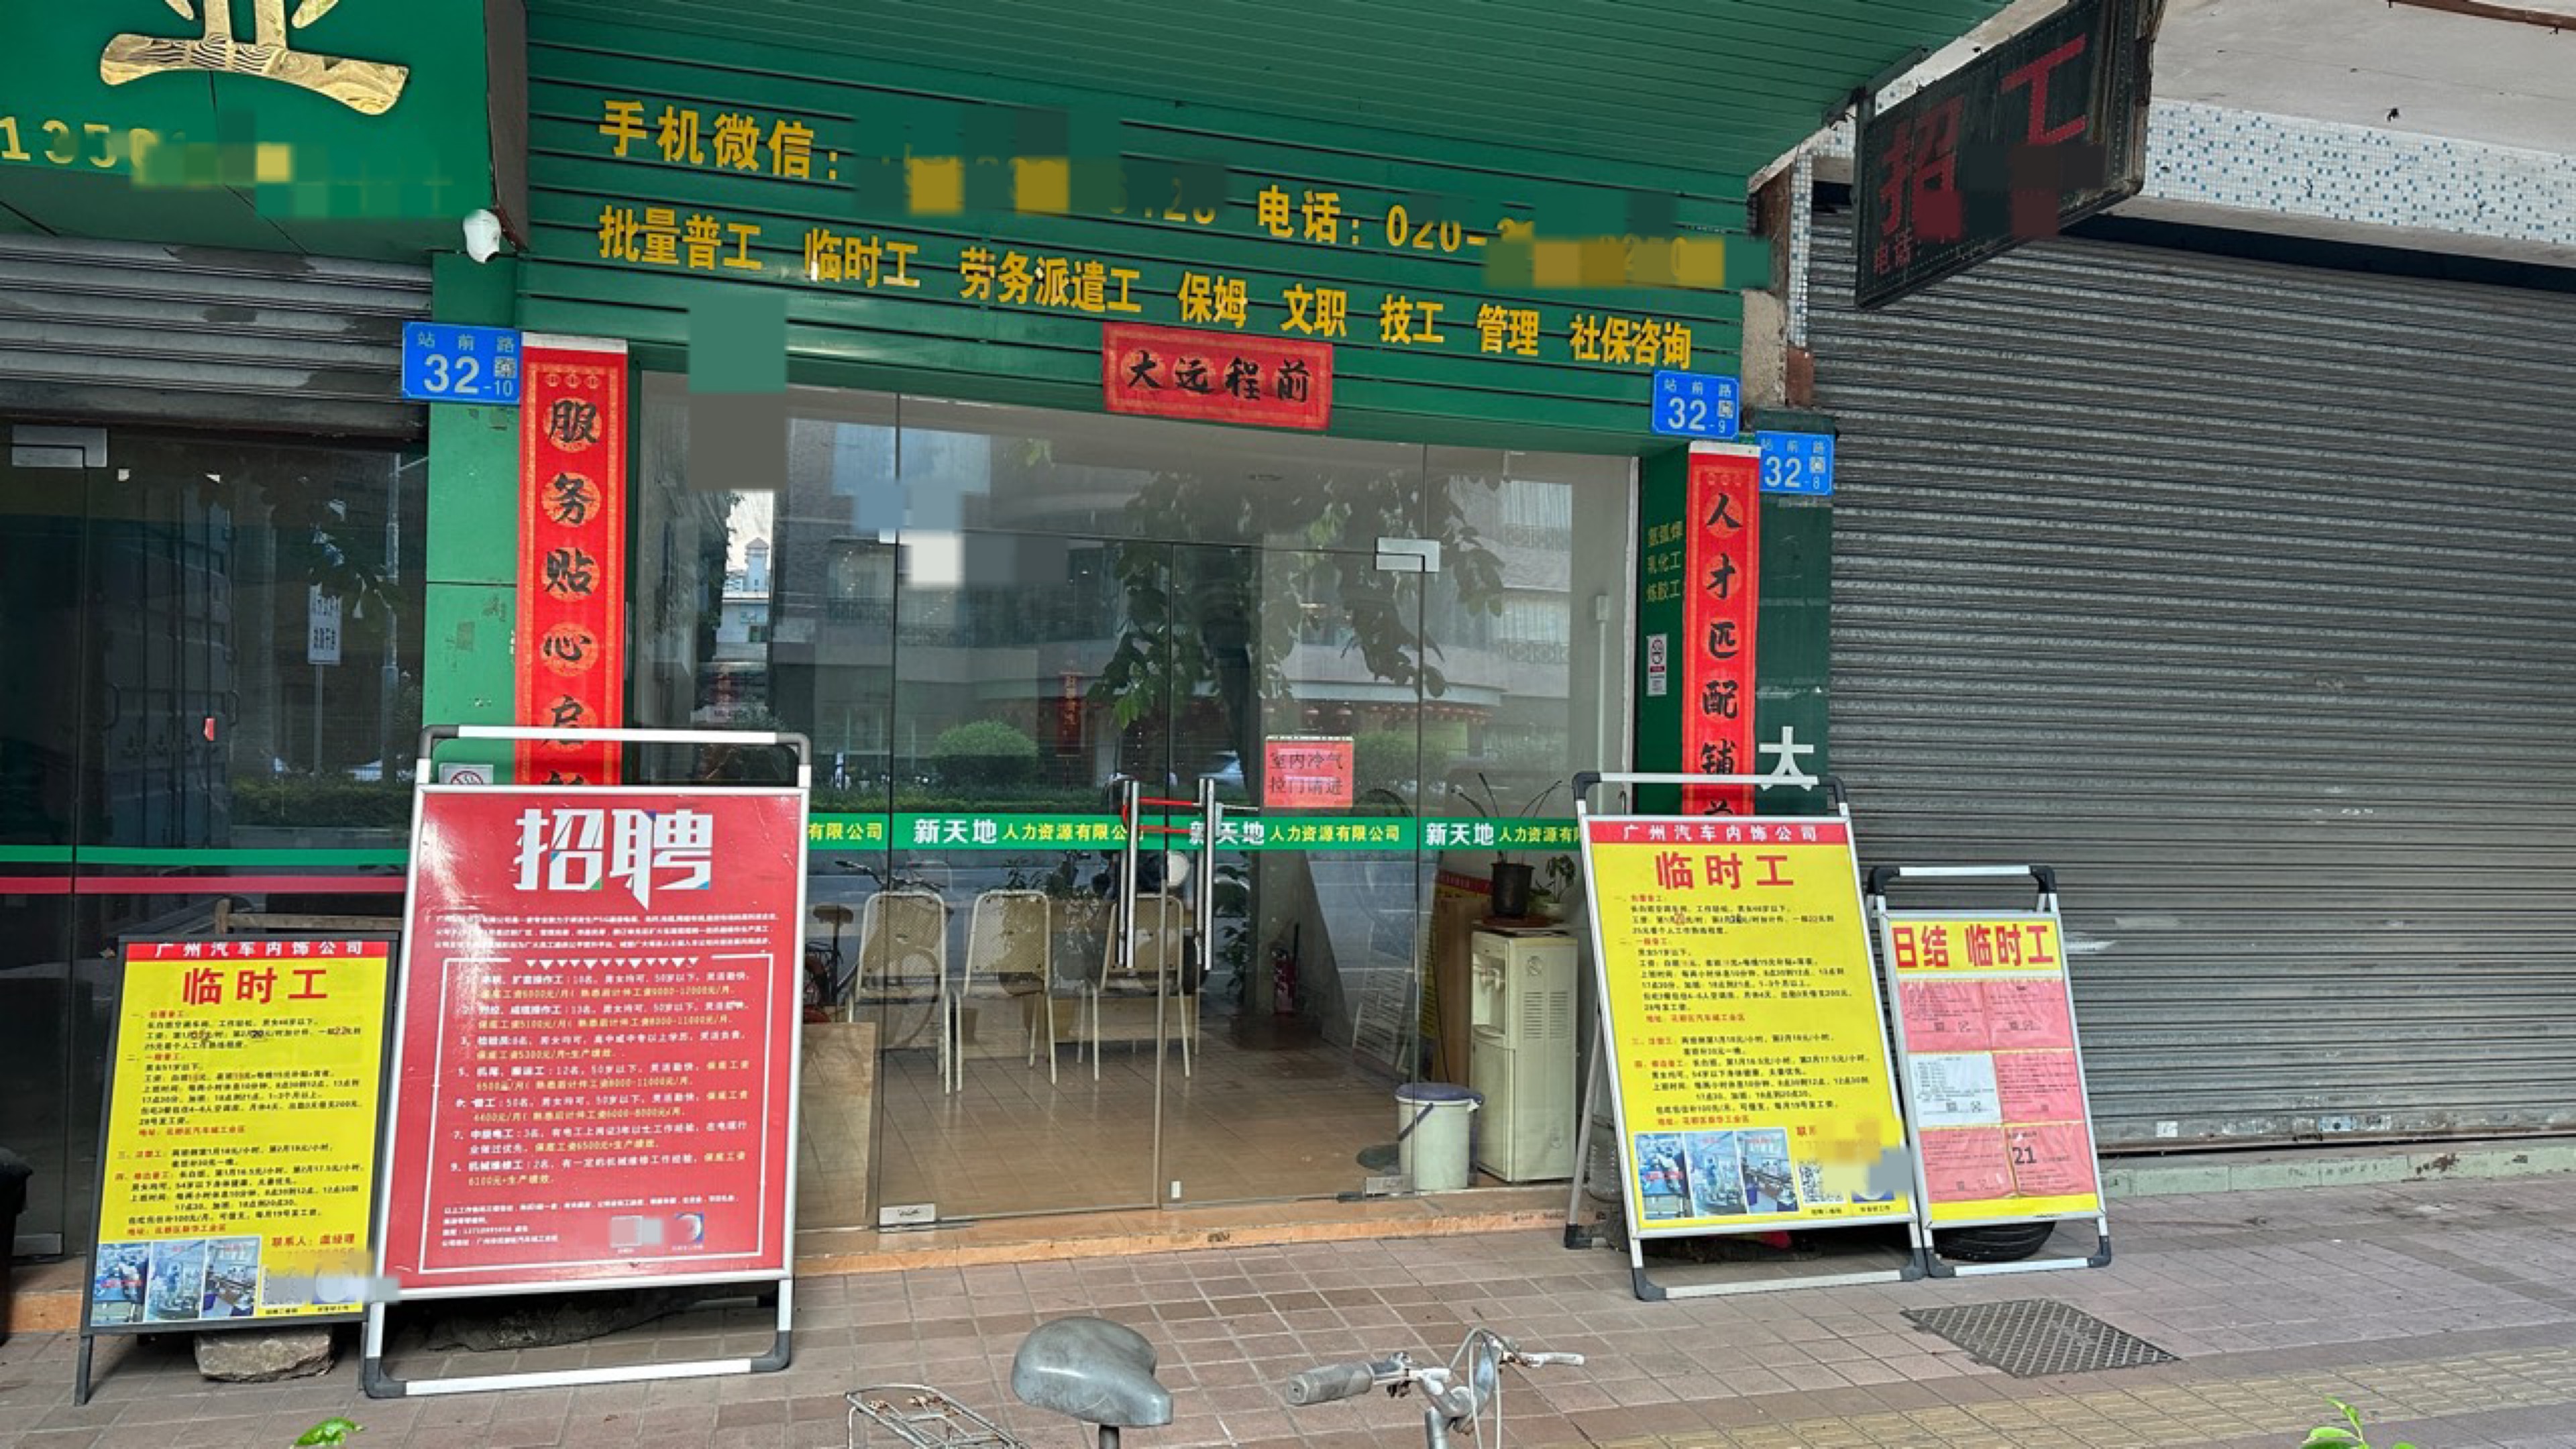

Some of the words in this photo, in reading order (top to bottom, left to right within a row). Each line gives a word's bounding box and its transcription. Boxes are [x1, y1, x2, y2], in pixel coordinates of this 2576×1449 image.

[598, 205, 762, 272] 批量普工
[805, 228, 920, 288] 临时工
[960, 246, 1142, 313] 劳务派遣工
[1178, 271, 1248, 330] 保姆
[1279, 283, 1348, 337] 文职
[1380, 294, 1445, 345] 技工
[1476, 304, 1540, 358] 管理
[1570, 313, 1692, 371] 社保咨询
[417, 330, 515, 353] 站前路
[1664, 378, 1732, 398] 站前路
[913, 818, 998, 845] 新天地
[1002, 824, 1144, 841] 人力资源有限公
[1270, 825, 1400, 842] 人力资源有限公司
[1426, 822, 1495, 846] 新天地
[1623, 825, 1819, 842] 广州汽车内饰公司
[513, 809, 713, 910] 招聘
[1655, 851, 1794, 890] 临时工
[154, 941, 364, 958] 广州汽车内饰公司
[1892, 924, 1949, 968] 日结
[1964, 923, 2055, 967] 临时工
[182, 967, 329, 1006] 临时工
[2012, 1144, 2037, 1165] 21
